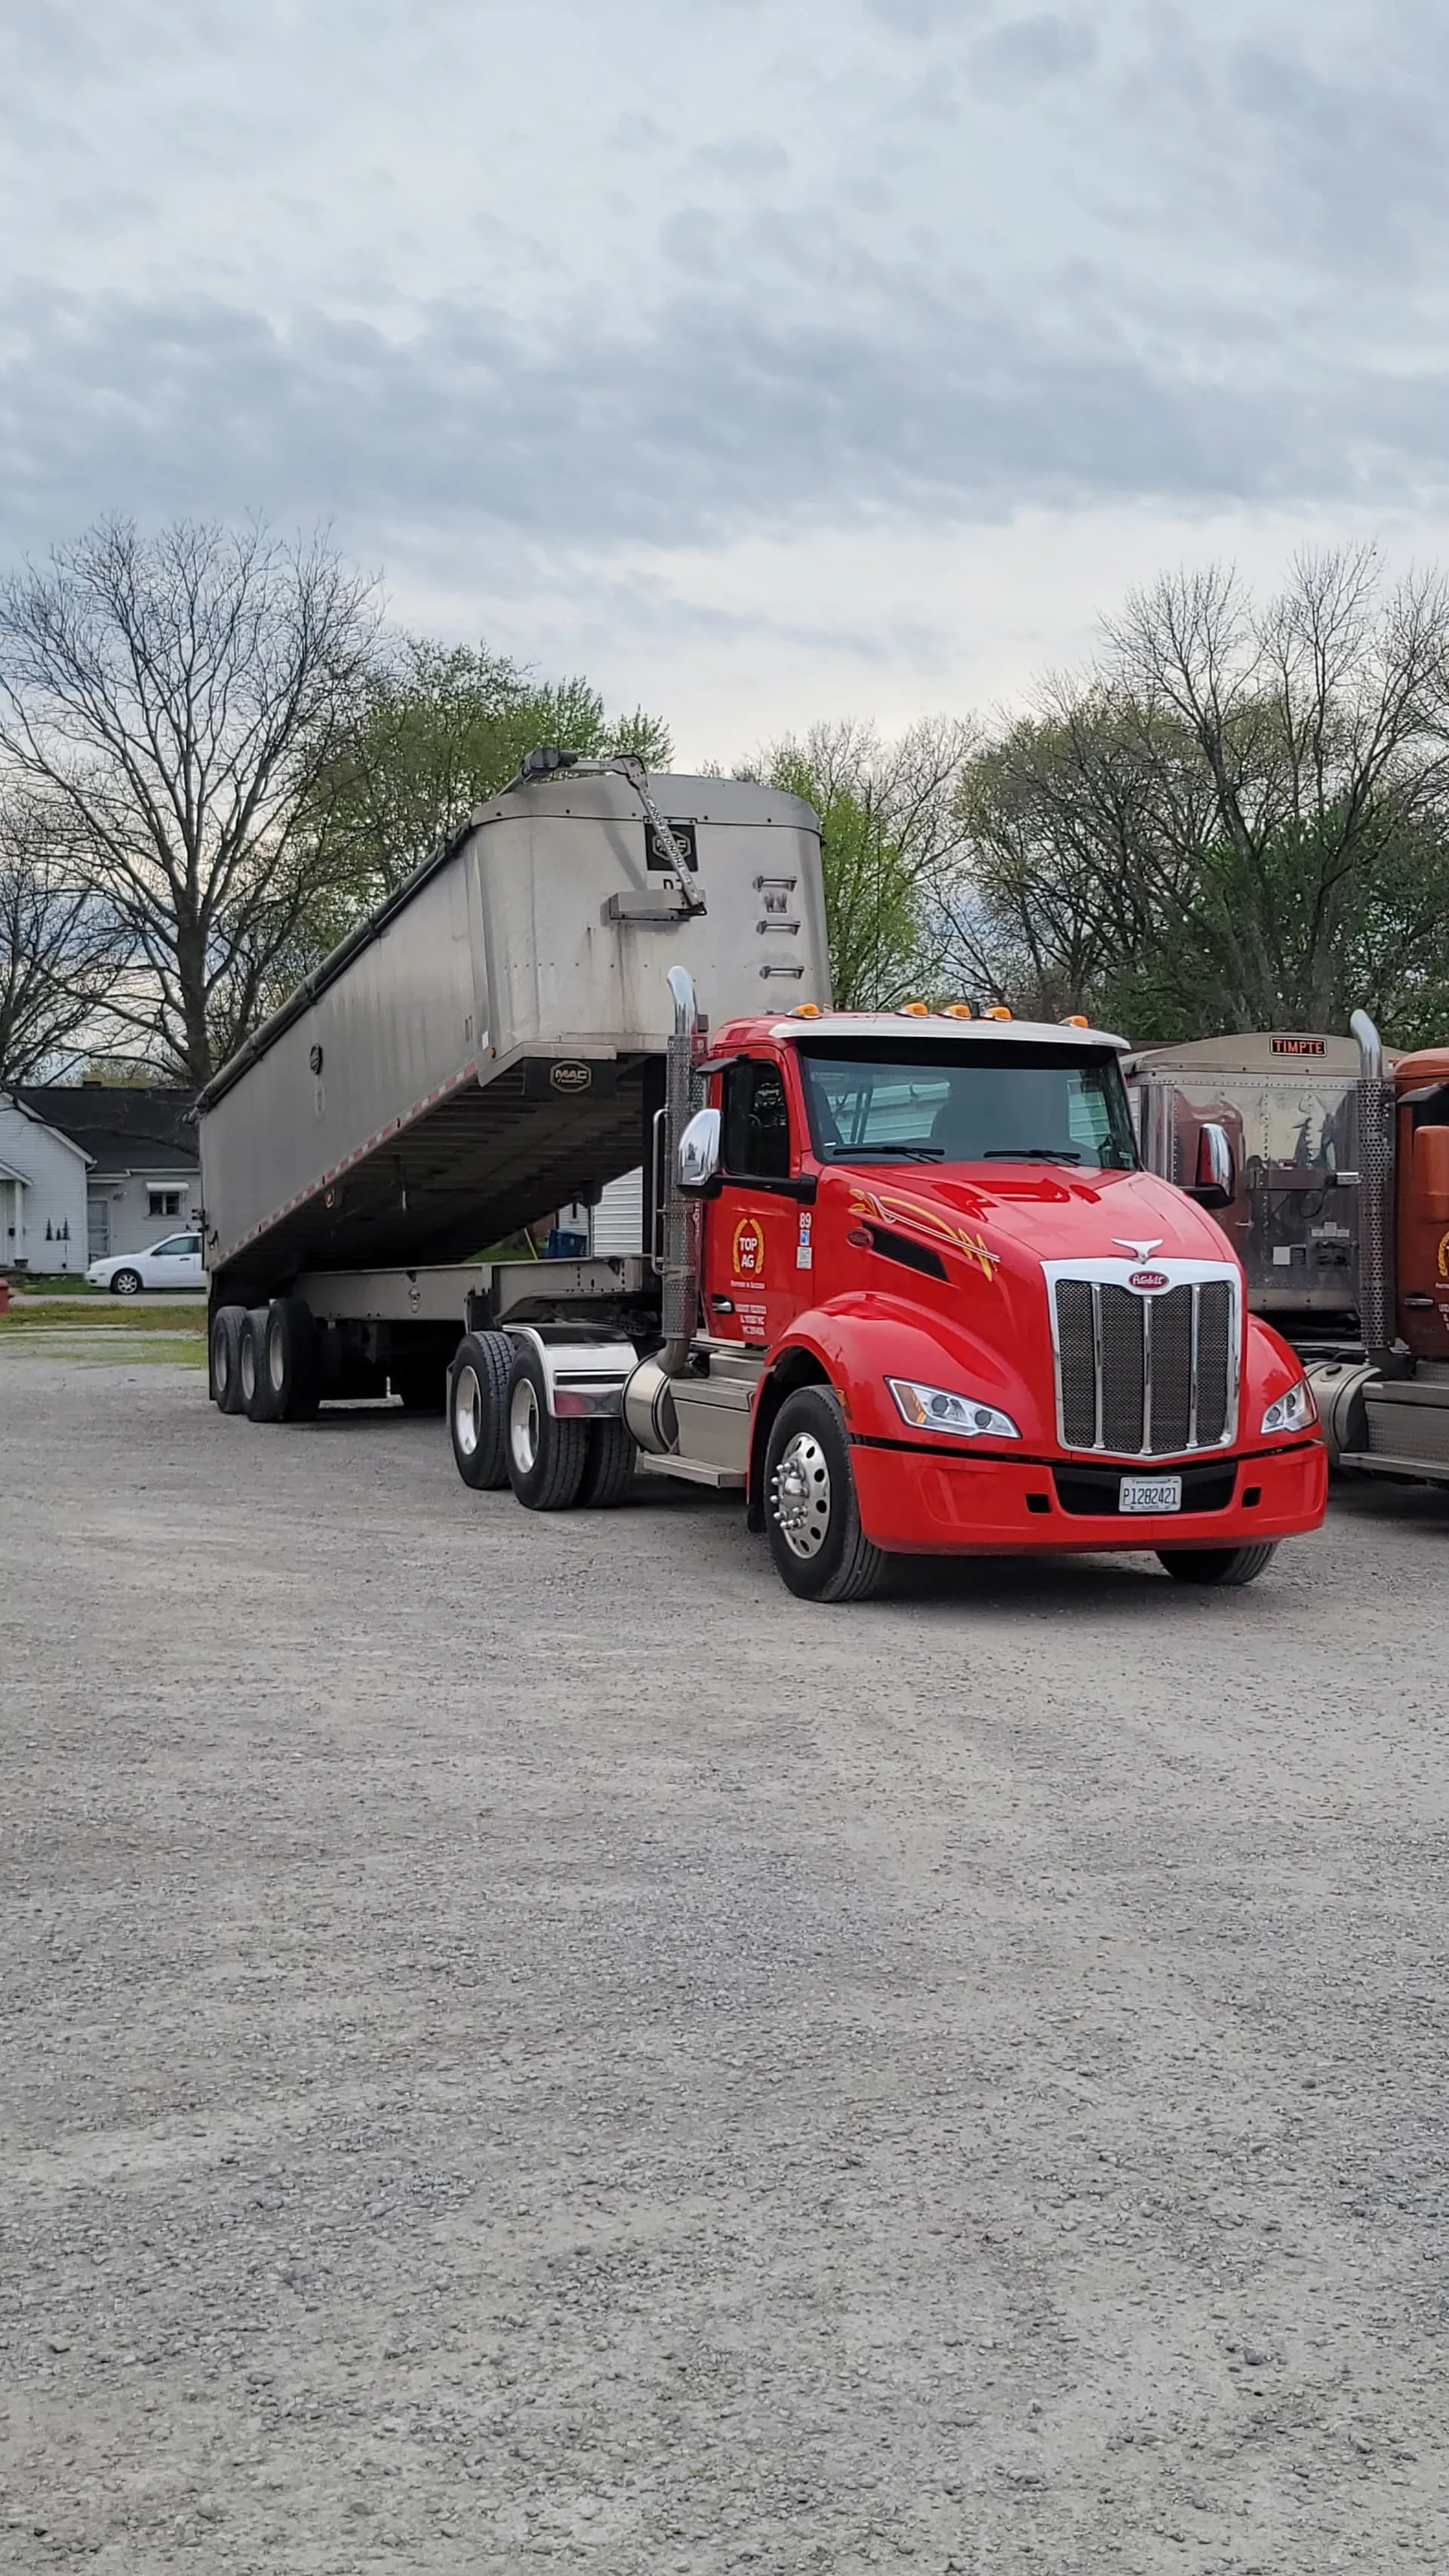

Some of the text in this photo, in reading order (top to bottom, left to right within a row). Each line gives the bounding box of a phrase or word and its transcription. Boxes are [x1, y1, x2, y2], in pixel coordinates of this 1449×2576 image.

[1274, 1040, 1323, 1054] TIMPTE
[555, 1069, 588, 1079] MAC
[799, 1212, 811, 1229] 89
[739, 1237, 758, 1251] TOP
[741, 1254, 755, 1268] AG
[1122, 1488, 1177, 1504] P1282421
